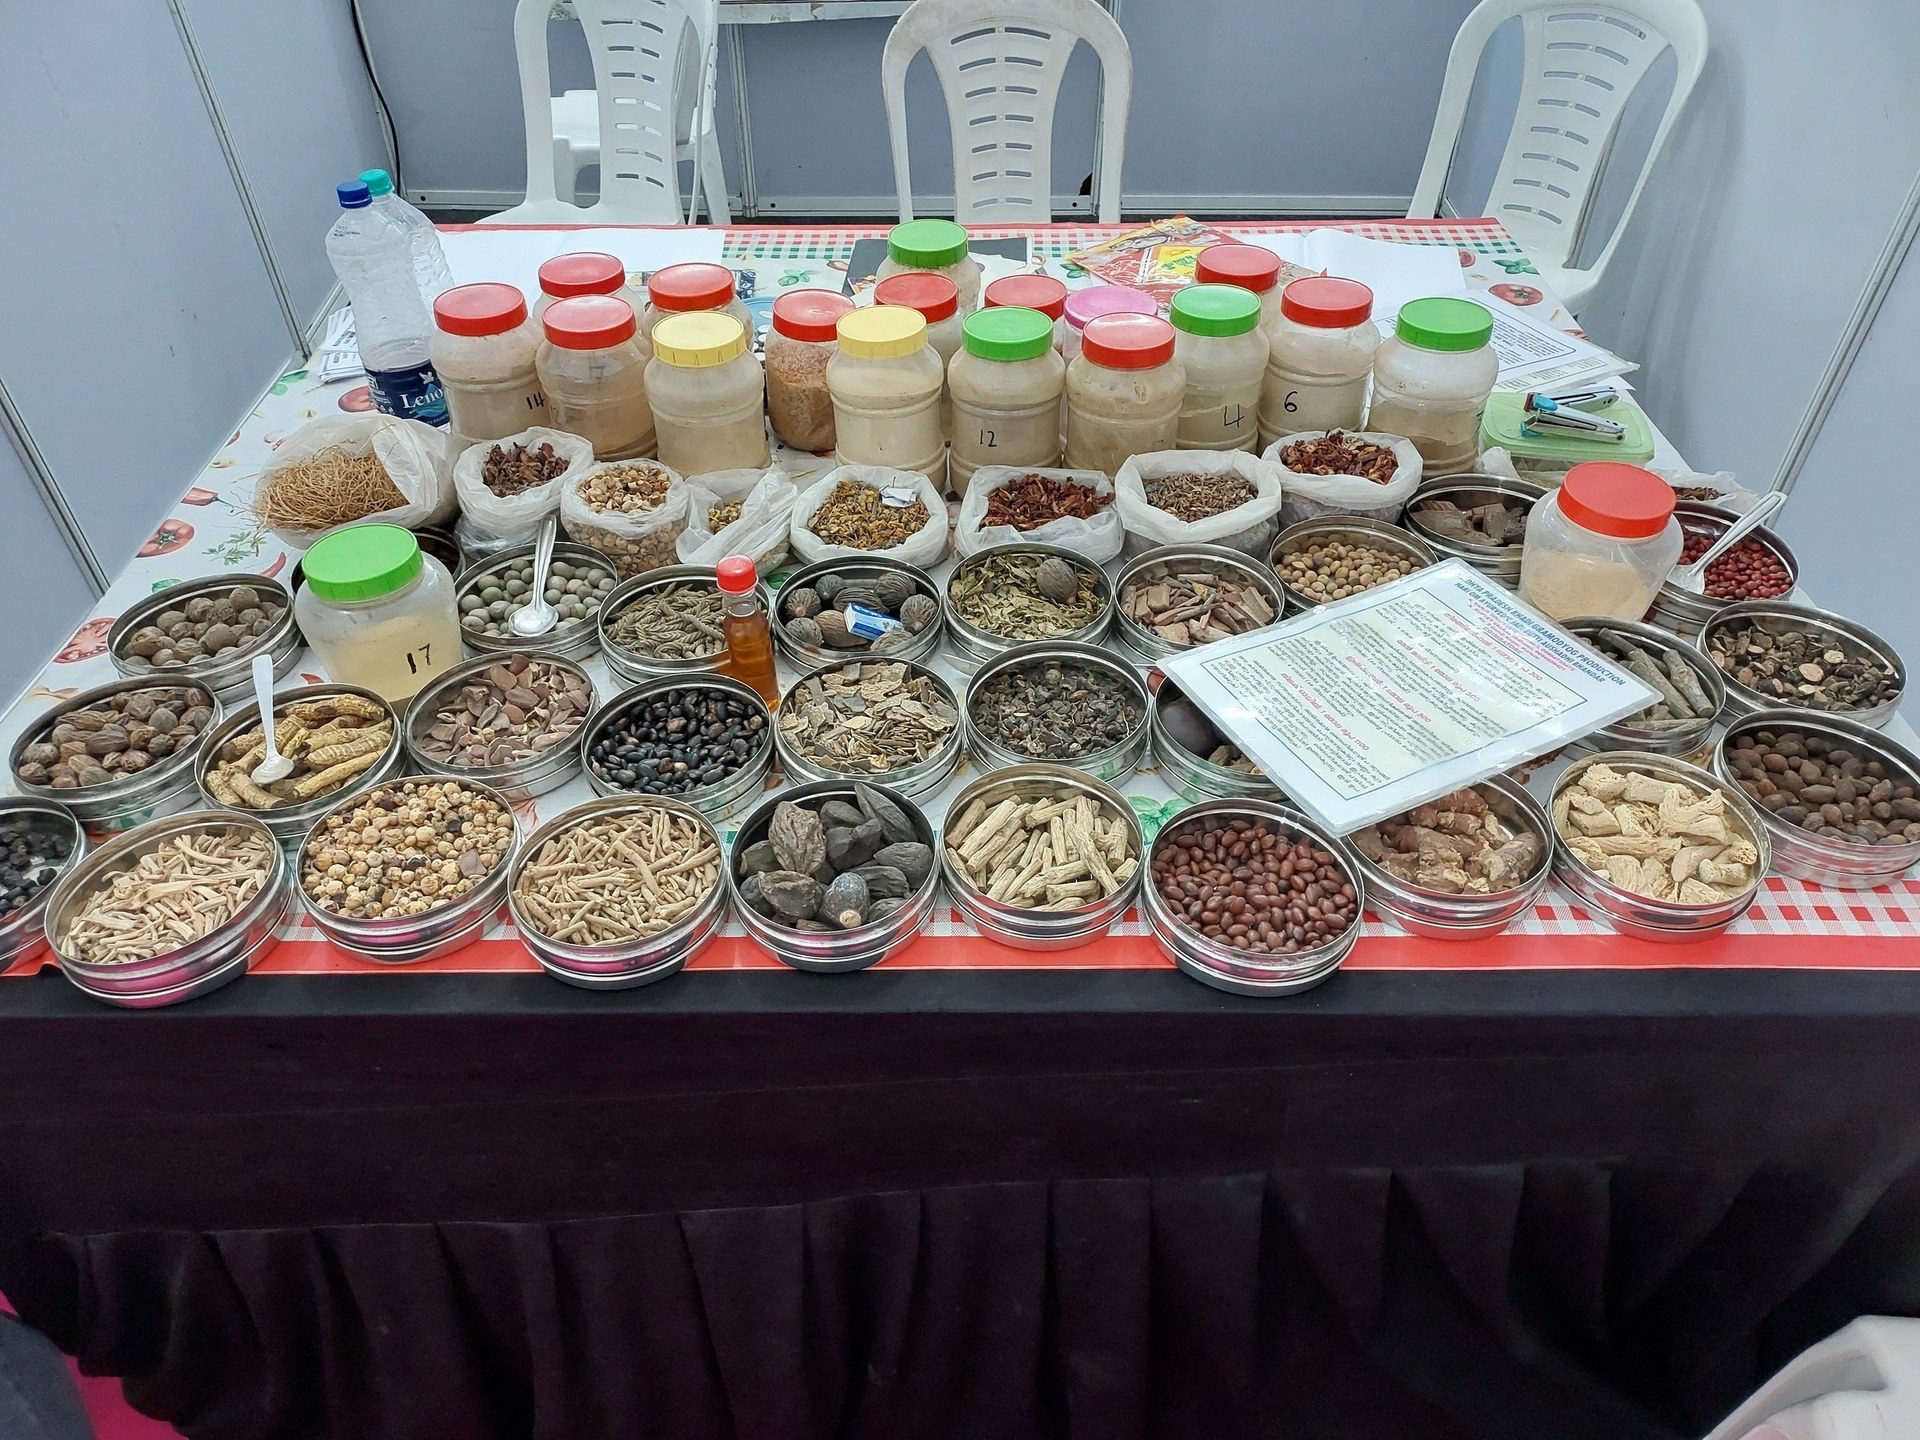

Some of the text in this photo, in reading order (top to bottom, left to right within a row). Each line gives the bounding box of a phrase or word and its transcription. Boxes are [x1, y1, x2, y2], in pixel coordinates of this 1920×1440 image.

[527, 391, 545, 410] 14
[1284, 391, 1298, 412] 6
[1223, 404, 1245, 428] 4
[979, 428, 998, 448] 12
[1454, 582, 1471, 594] HARI
[1468, 591, 1481, 600] OM
[1541, 640, 1575, 663] AUSHADHI
[1572, 661, 1606, 683] BHANDAR
[1482, 590, 1513, 614] PRADESH
[1511, 608, 1534, 627] KHADI
[1531, 622, 1579, 656] GRAMODYOG
[1576, 653, 1626, 686] PRODUCTION
[406, 643, 431, 674] 17
